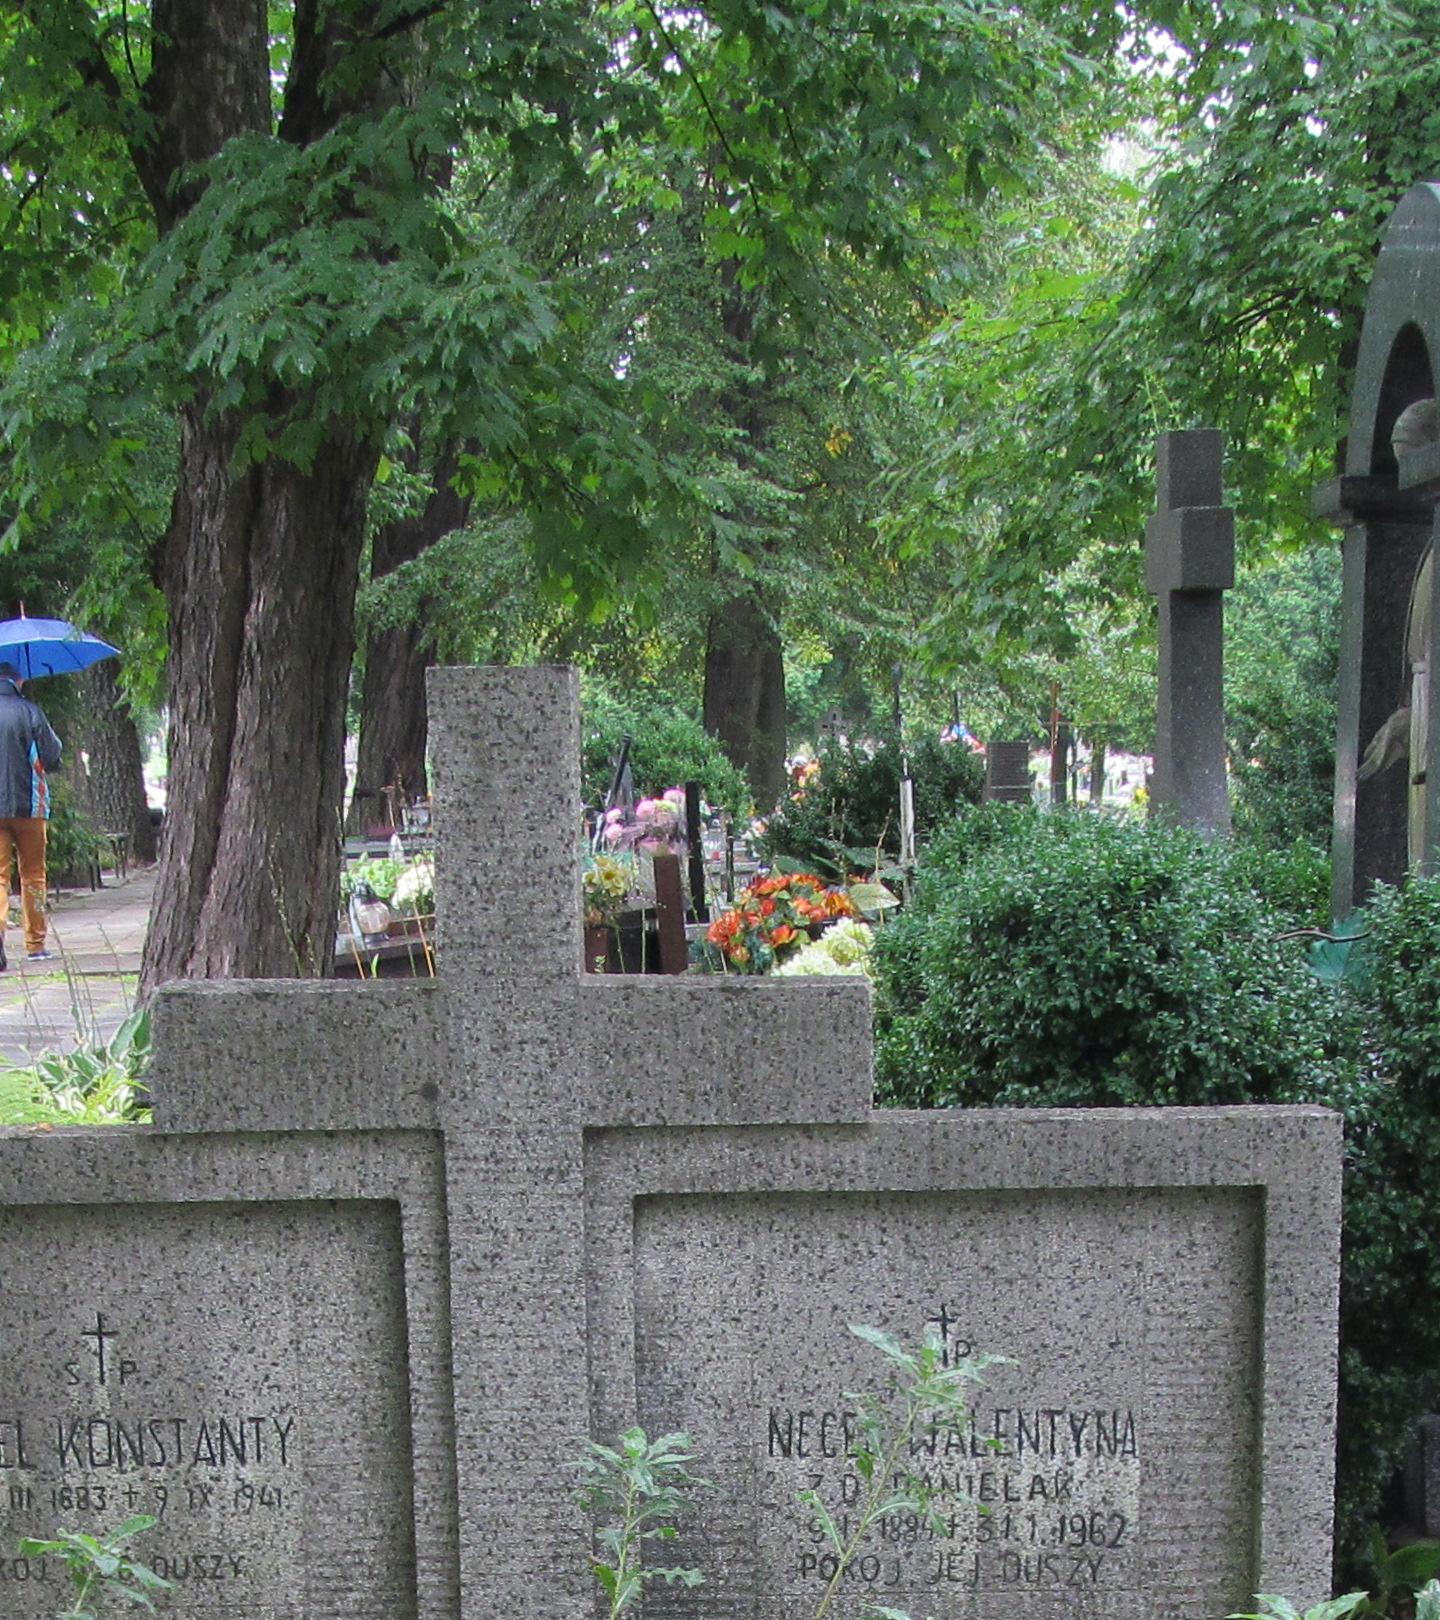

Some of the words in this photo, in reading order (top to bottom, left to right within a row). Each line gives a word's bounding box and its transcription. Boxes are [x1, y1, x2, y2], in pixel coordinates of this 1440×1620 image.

[58, 1416, 295, 1471] KONSTANTY
[909, 1407, 1138, 1459] WALENTYNA
[153, 1555, 247, 1580] DUSZY
[797, 1552, 901, 1586] POKOJ
[924, 1551, 980, 1587] JEJ
[1002, 1552, 1106, 1586] DUSZY
